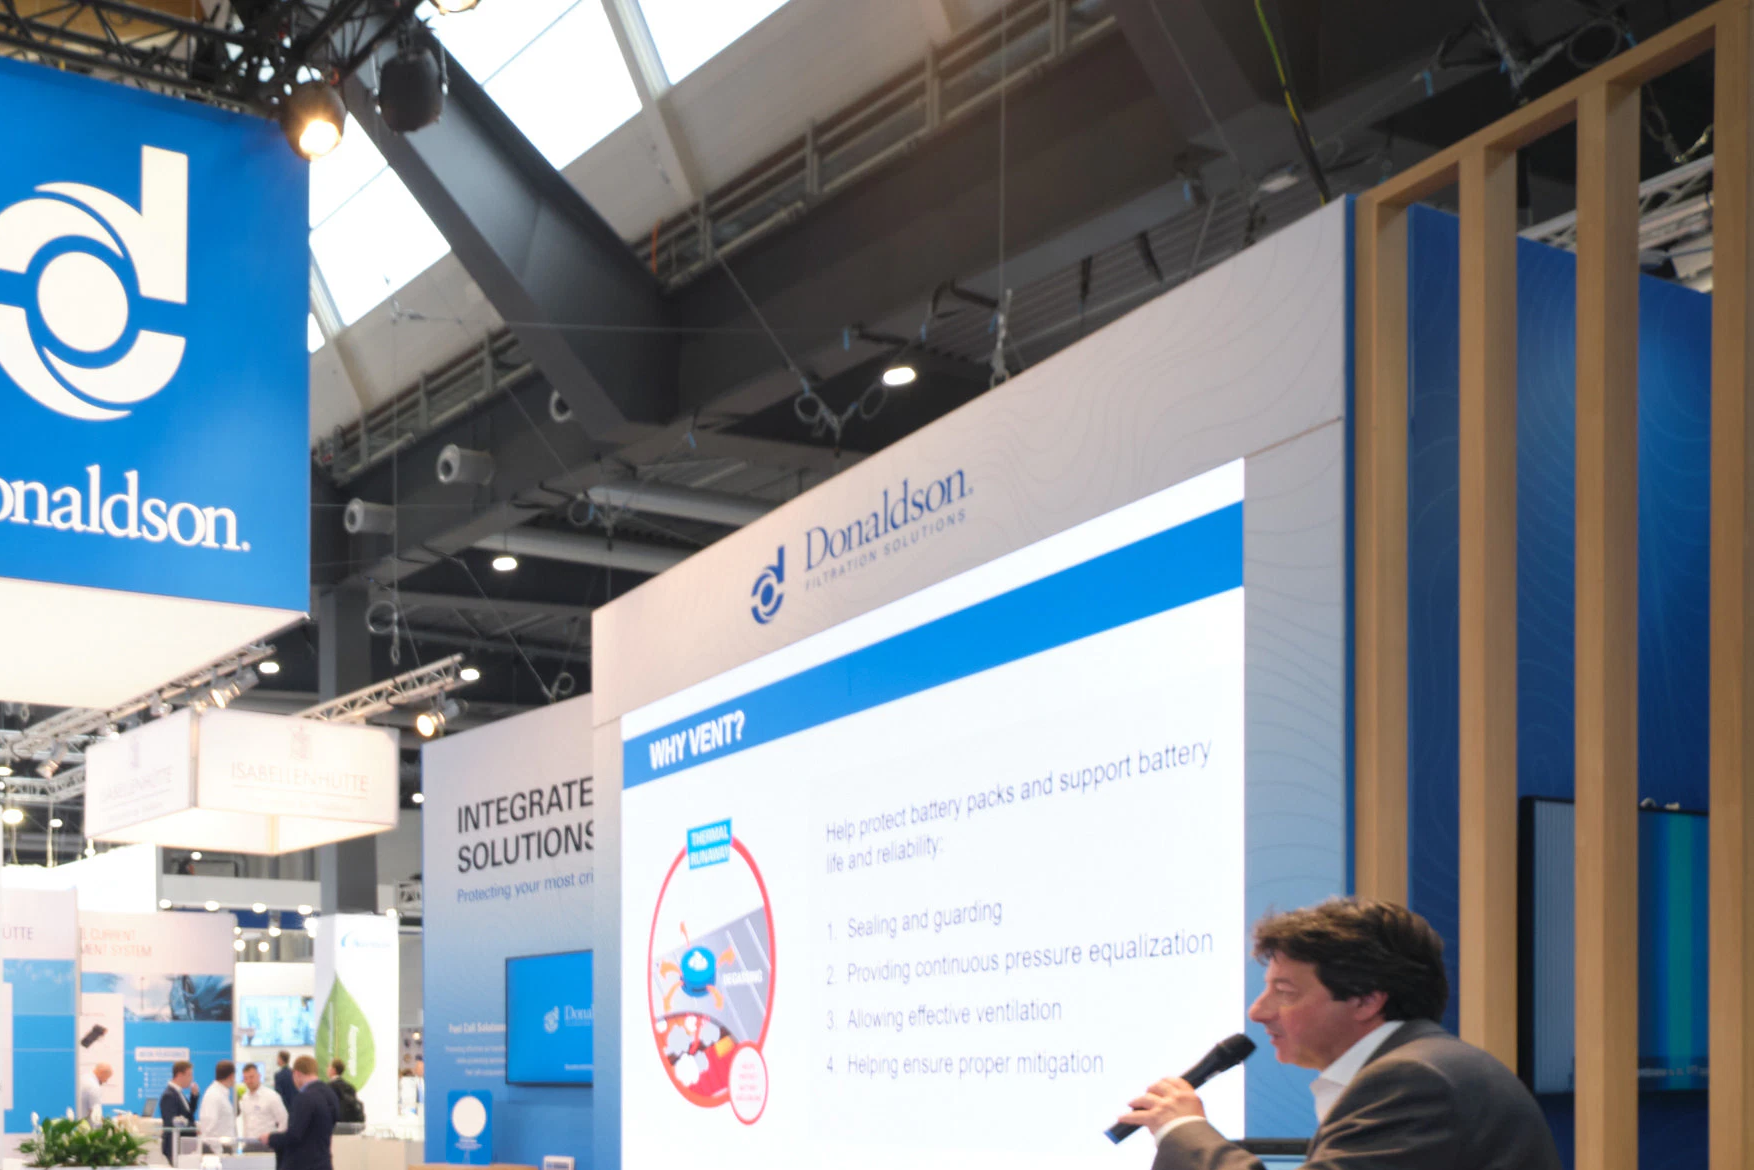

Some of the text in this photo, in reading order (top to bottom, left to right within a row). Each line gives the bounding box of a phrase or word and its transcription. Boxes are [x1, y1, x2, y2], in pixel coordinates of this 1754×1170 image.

[883, 508, 967, 557] SOLUTIONS
[805, 550, 878, 592] FILTRATION
[649, 710, 746, 770] WHY VENT?
[458, 776, 593, 834] INTEGRATE
[826, 739, 1212, 843] Help protect battery packs and support battery
[690, 824, 729, 847] THERMAL
[826, 834, 944, 874] life and reliability:
[457, 882, 512, 903] Protecting
[514, 880, 540, 896] your
[544, 872, 575, 890] most
[847, 914, 897, 940] Sealing
[902, 908, 929, 931] and
[933, 901, 1003, 934] guarding
[826, 929, 1214, 985] 2. Providing continuous pressure equalization
[826, 998, 1062, 1033] 3. Allowing effective ventilation
[847, 1054, 899, 1079] Helping
[903, 1056, 954, 1075] ensure
[958, 1053, 1011, 1080] proper
[1017, 1052, 1104, 1080] mitigation
